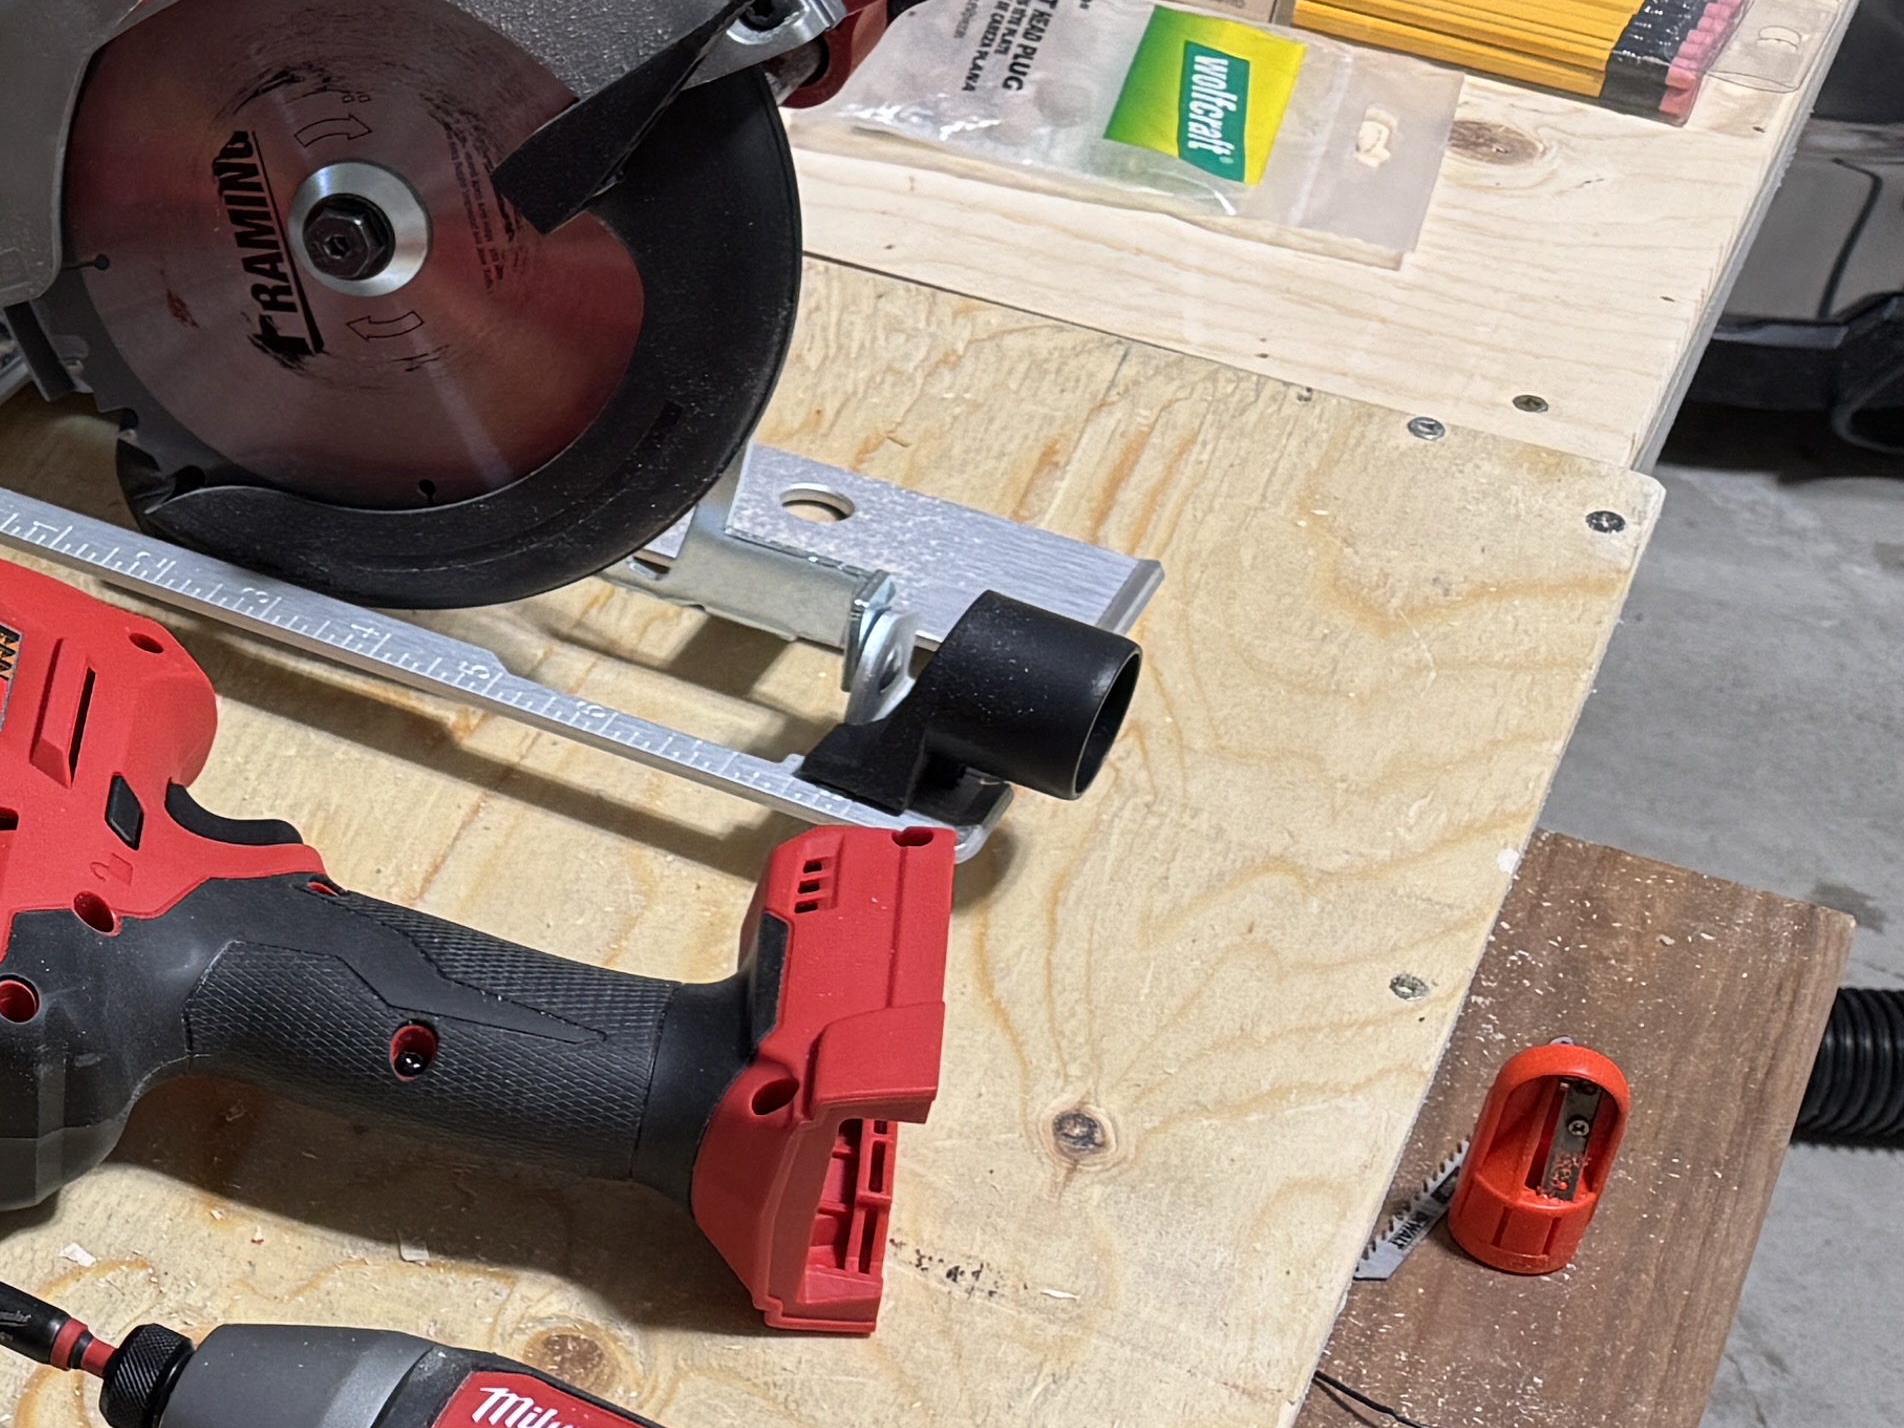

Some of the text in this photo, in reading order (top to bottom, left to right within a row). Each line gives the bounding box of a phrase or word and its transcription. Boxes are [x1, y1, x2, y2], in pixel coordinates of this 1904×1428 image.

[1022, 7, 1052, 44] HEAD
[961, 48, 989, 94] PLANA
[1001, 41, 1037, 94] PLUG
[1188, 55, 1238, 156] wolfcraft
[212, 131, 314, 355] FRAMING
